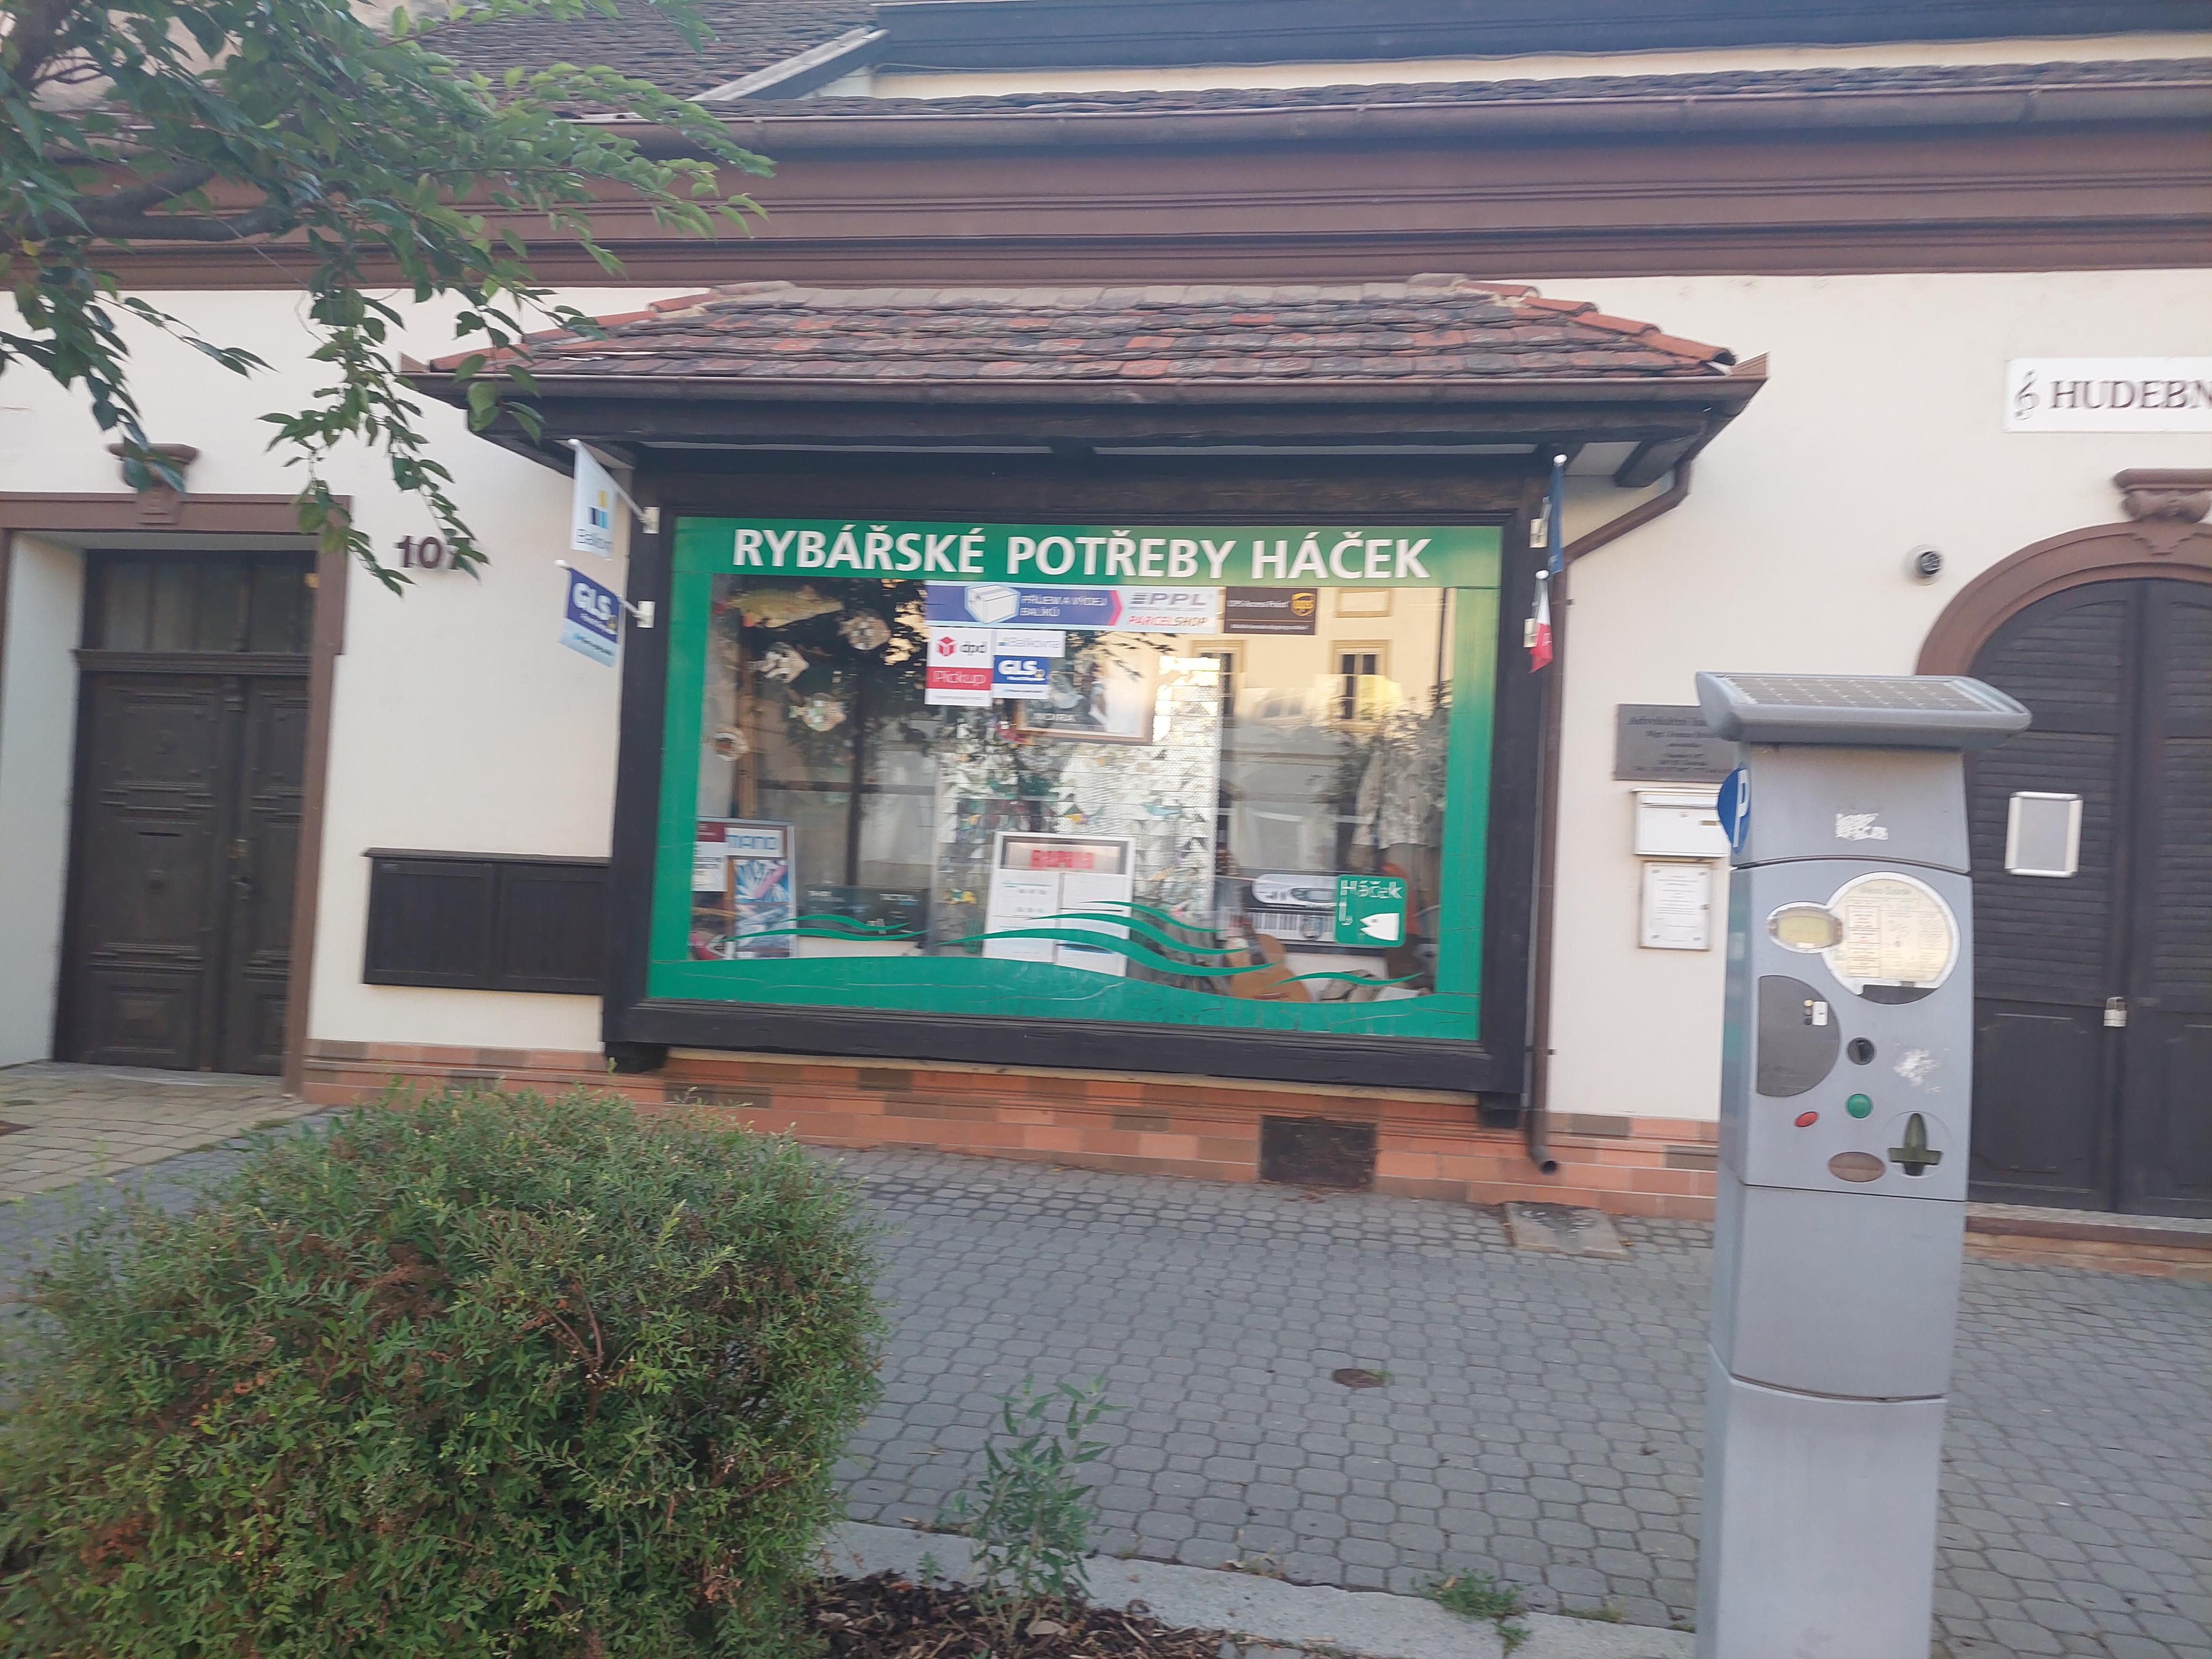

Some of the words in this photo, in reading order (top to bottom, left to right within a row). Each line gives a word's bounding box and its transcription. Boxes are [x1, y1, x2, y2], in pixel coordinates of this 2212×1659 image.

[733, 524, 987, 574] RYBÁŘSKÉ
[1007, 530, 1237, 580] POTŘEBY
[1250, 530, 1432, 580] HÁČEK
[572, 582, 612, 620] GLS
[1149, 592, 1208, 606] PPL
[959, 641, 988, 656] dpd
[998, 659, 1039, 676] GLS
[932, 670, 987, 687] Pickup
[1733, 769, 1749, 848] P
[1340, 879, 1403, 900] Háček
